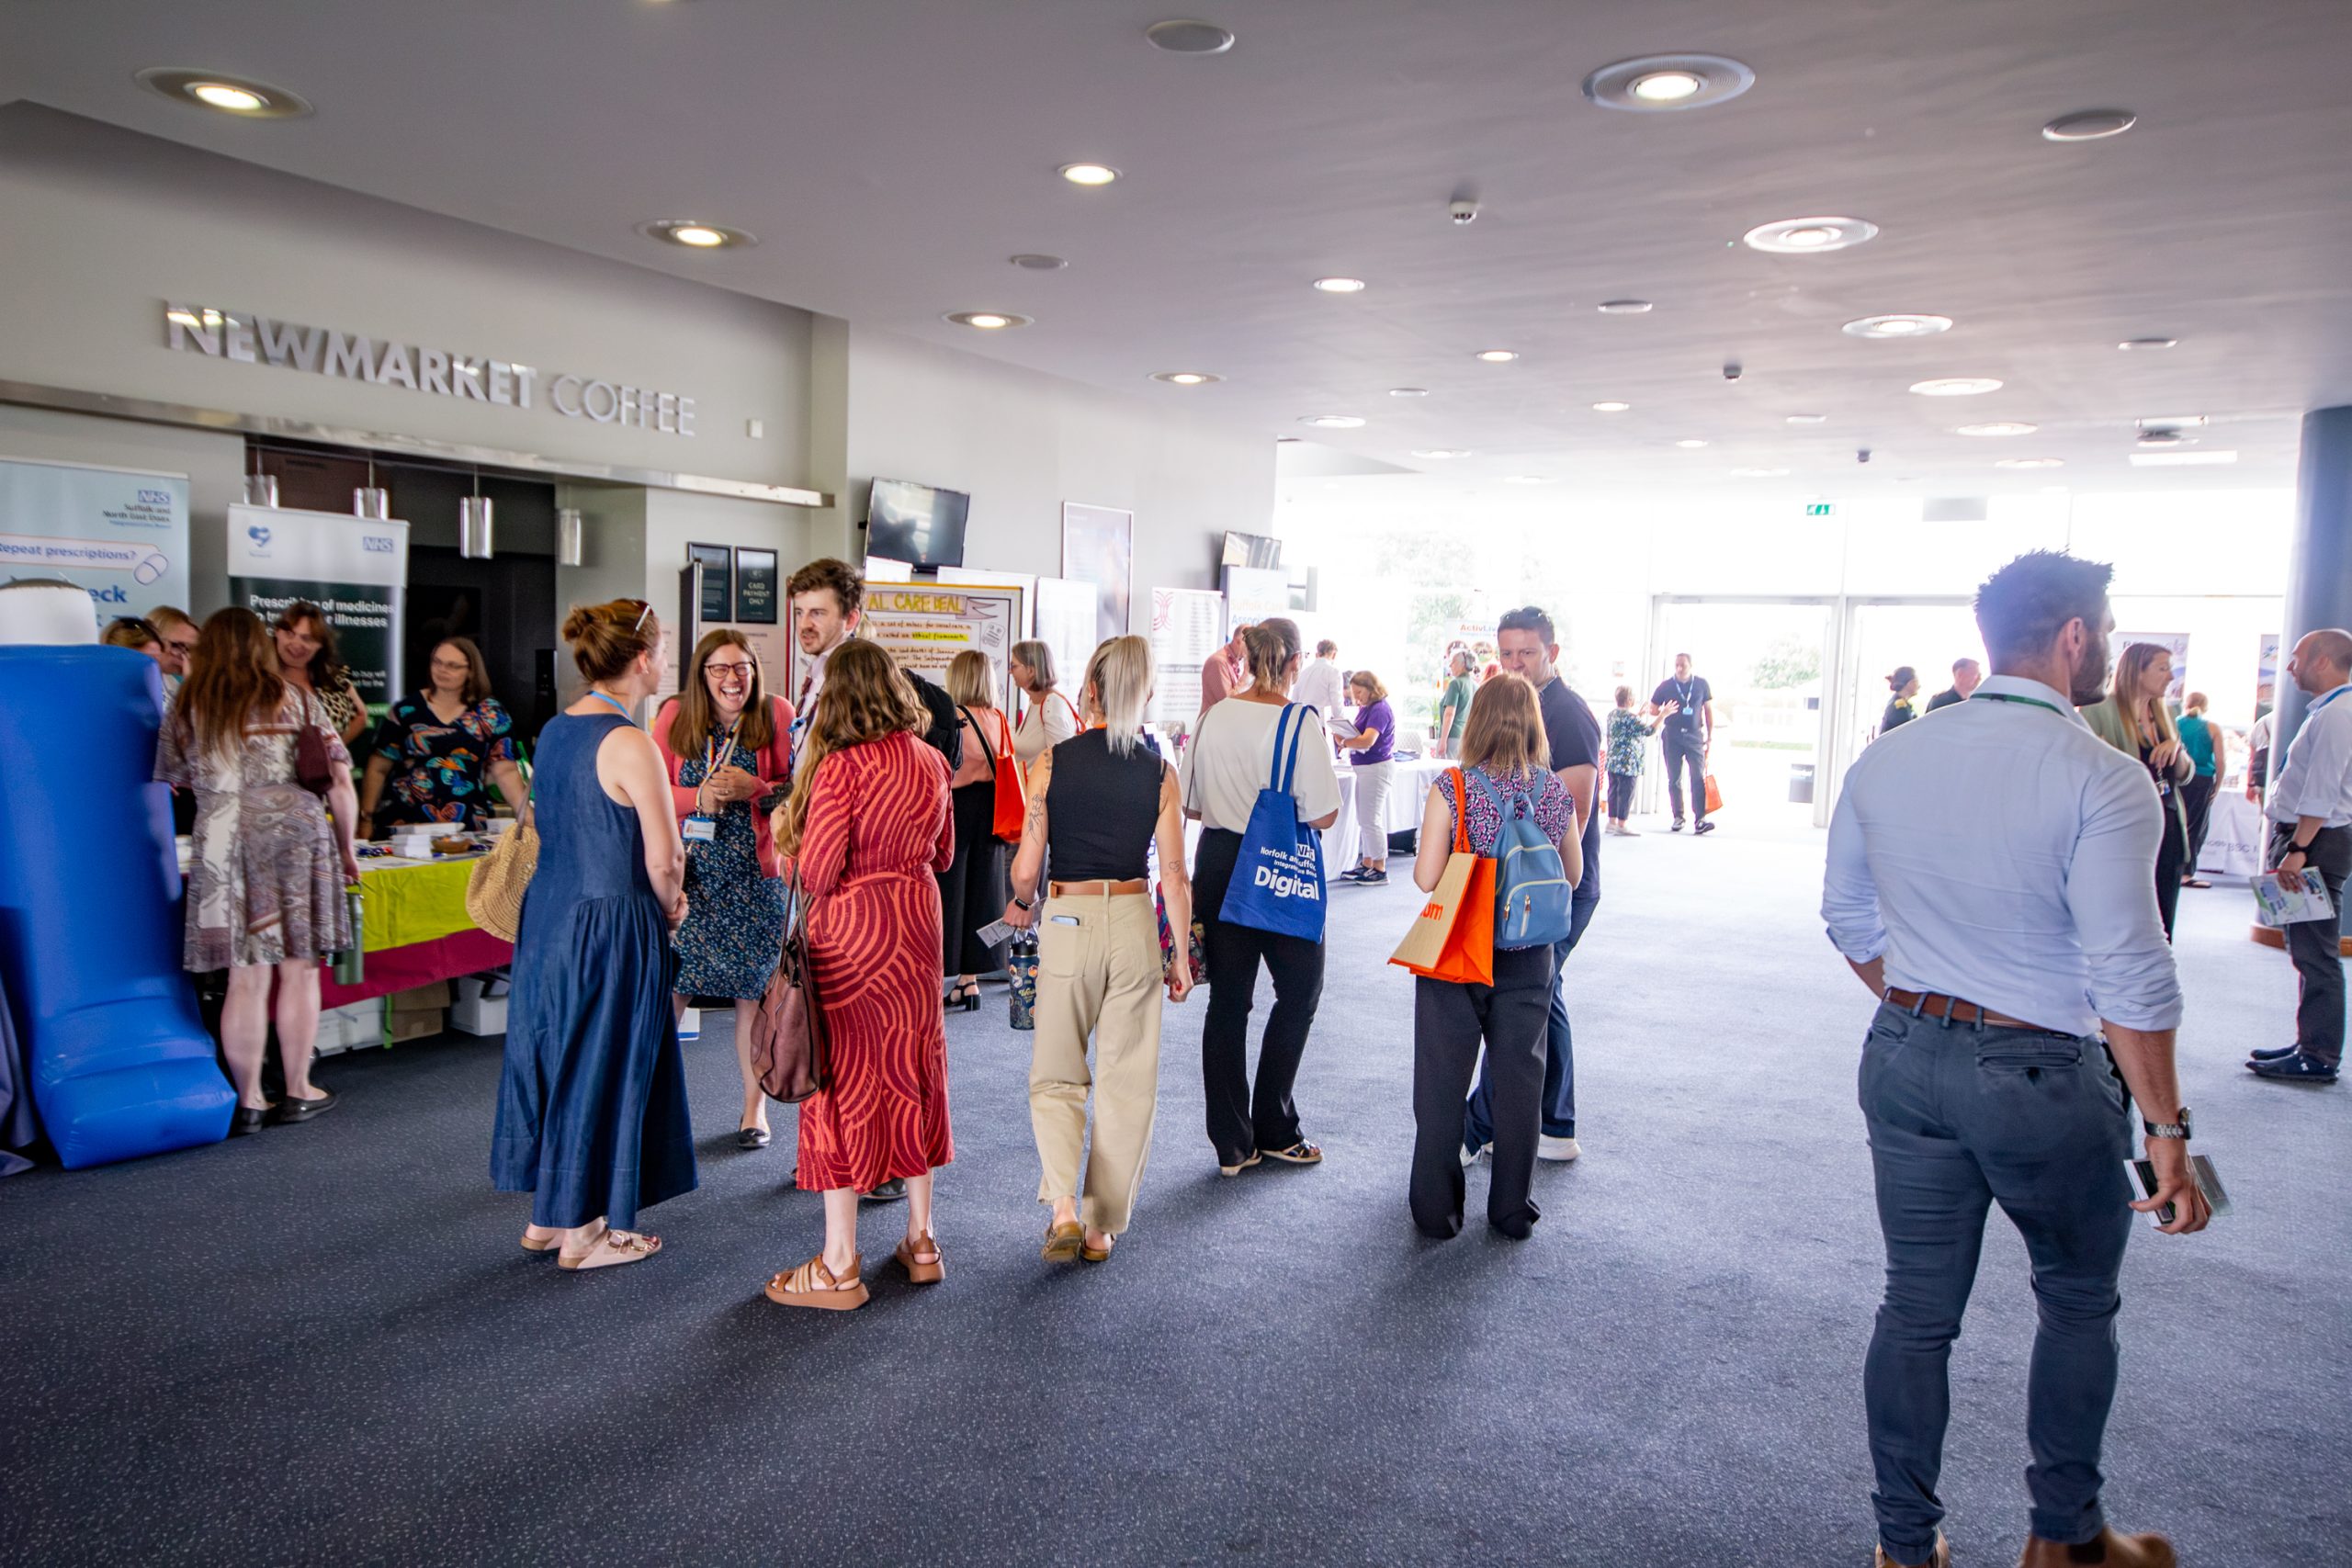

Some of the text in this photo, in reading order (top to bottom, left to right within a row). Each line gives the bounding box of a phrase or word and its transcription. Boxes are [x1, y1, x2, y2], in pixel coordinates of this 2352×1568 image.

[165, 301, 695, 436] NEWMARKET COFFEE
[139, 490, 170, 503] NHS
[364, 536, 393, 551] NHS
[46, 547, 137, 560] prescriptions?
[87, 584, 128, 604] eck
[322, 599, 334, 612] of
[336, 600, 397, 614] medicines
[893, 592, 931, 613] CARE
[334, 614, 389, 628] illnesses
[1460, 624, 1497, 632] ActivLiv
[1261, 846, 1288, 861] Norfolk
[1254, 865, 1320, 901] Digital
